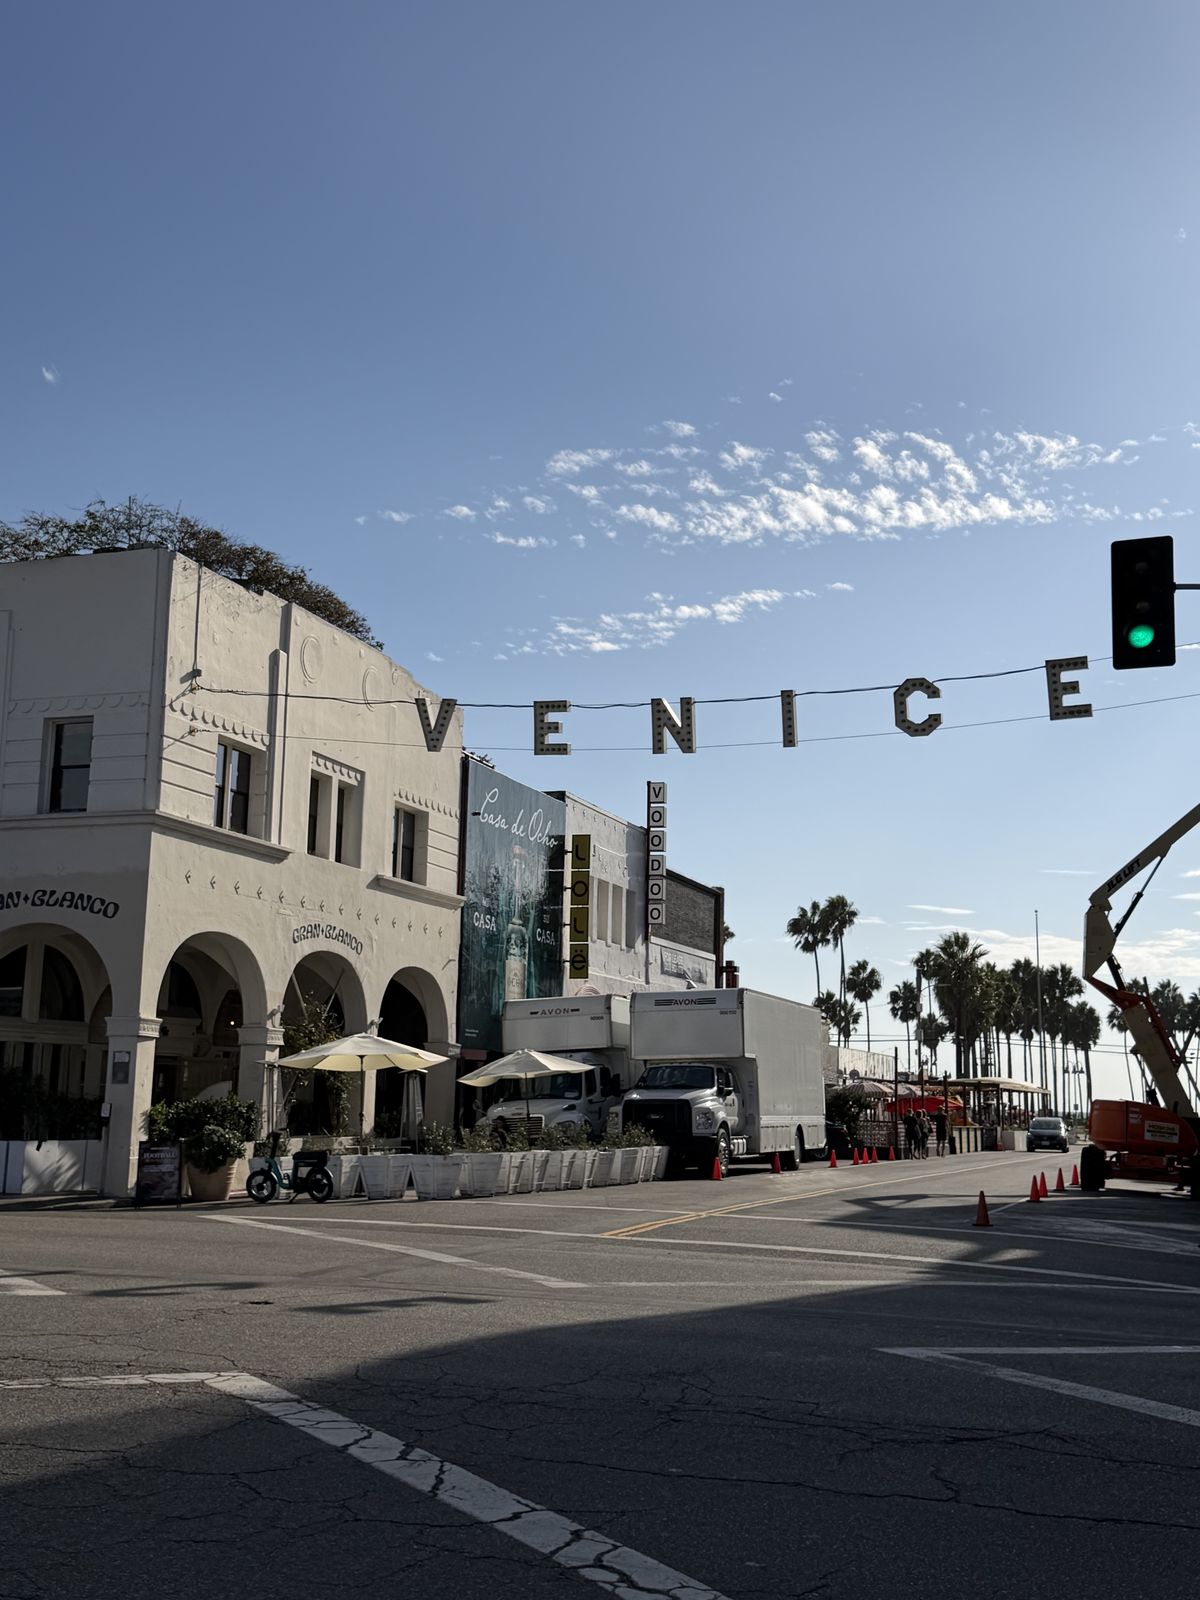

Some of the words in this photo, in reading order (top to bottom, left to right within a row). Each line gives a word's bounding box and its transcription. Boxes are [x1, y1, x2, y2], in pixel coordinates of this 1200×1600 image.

[415, 655, 1092, 755] VENICE
[480, 788, 508, 829] Casa
[511, 809, 525, 837] de
[528, 808, 558, 848] Ocho
[650, 786, 662, 920] VOODOO
[1107, 874, 1122, 892] JLG
[1123, 859, 1140, 878] LIFT
[31, 889, 120, 919] BLANCO
[473, 911, 497, 931] CASA
[292, 923, 321, 944] GRAN
[325, 924, 363, 955] BLANCO
[536, 928, 556, 946] CASA
[540, 1007, 570, 1016] AVON
[673, 998, 697, 1006] AVON
